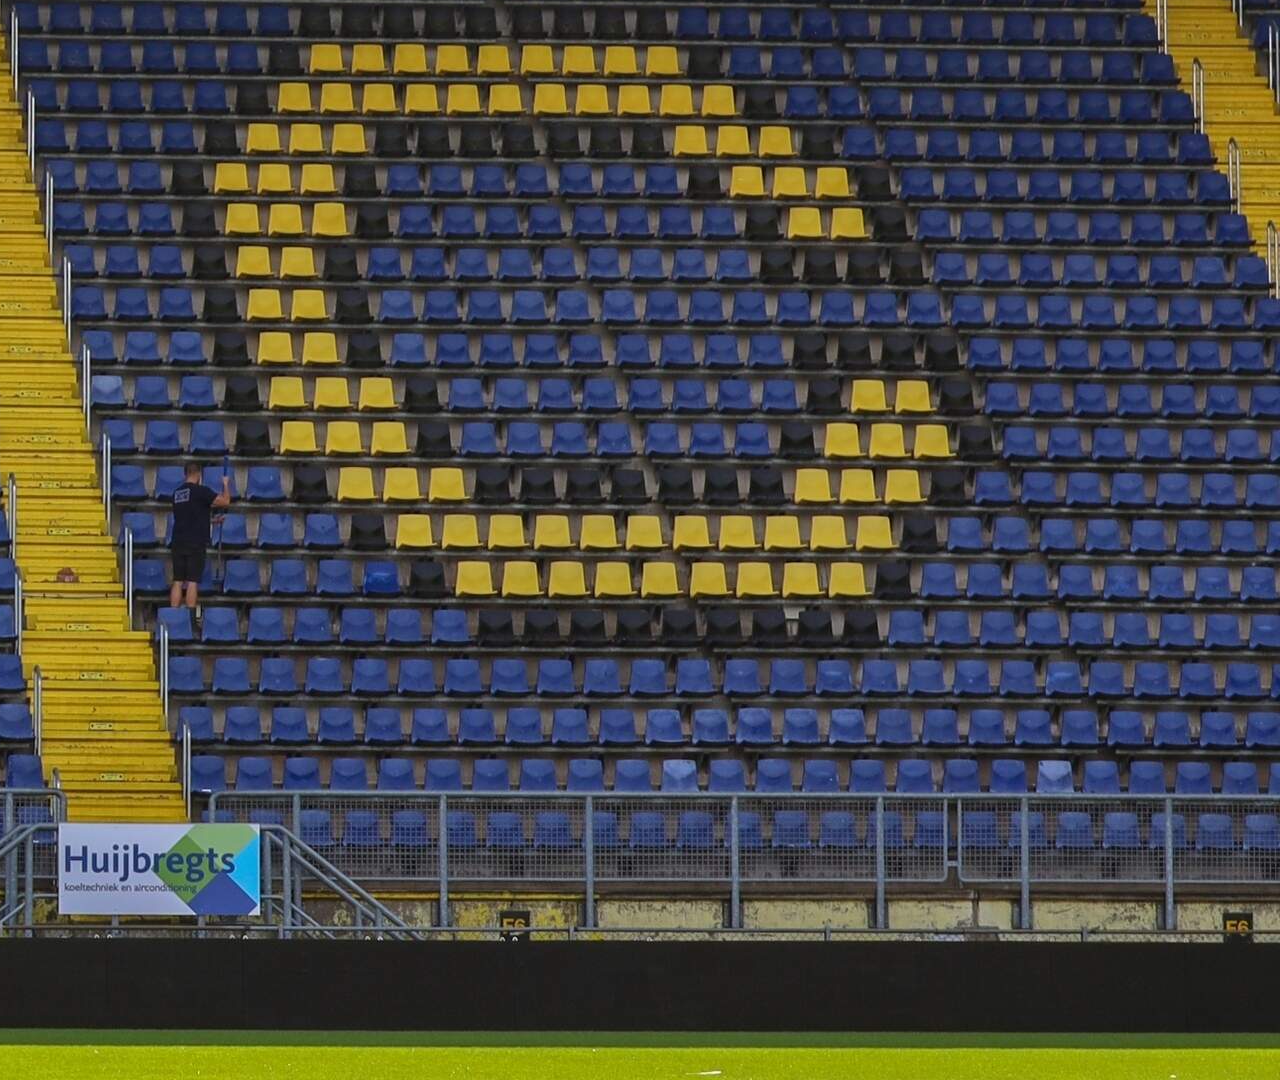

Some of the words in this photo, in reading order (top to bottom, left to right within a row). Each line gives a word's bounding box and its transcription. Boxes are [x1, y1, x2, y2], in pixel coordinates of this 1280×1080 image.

[64, 843, 236, 883] Huijbregts
[64, 882, 120, 893] koeltechniek
[121, 884, 132, 893] en
